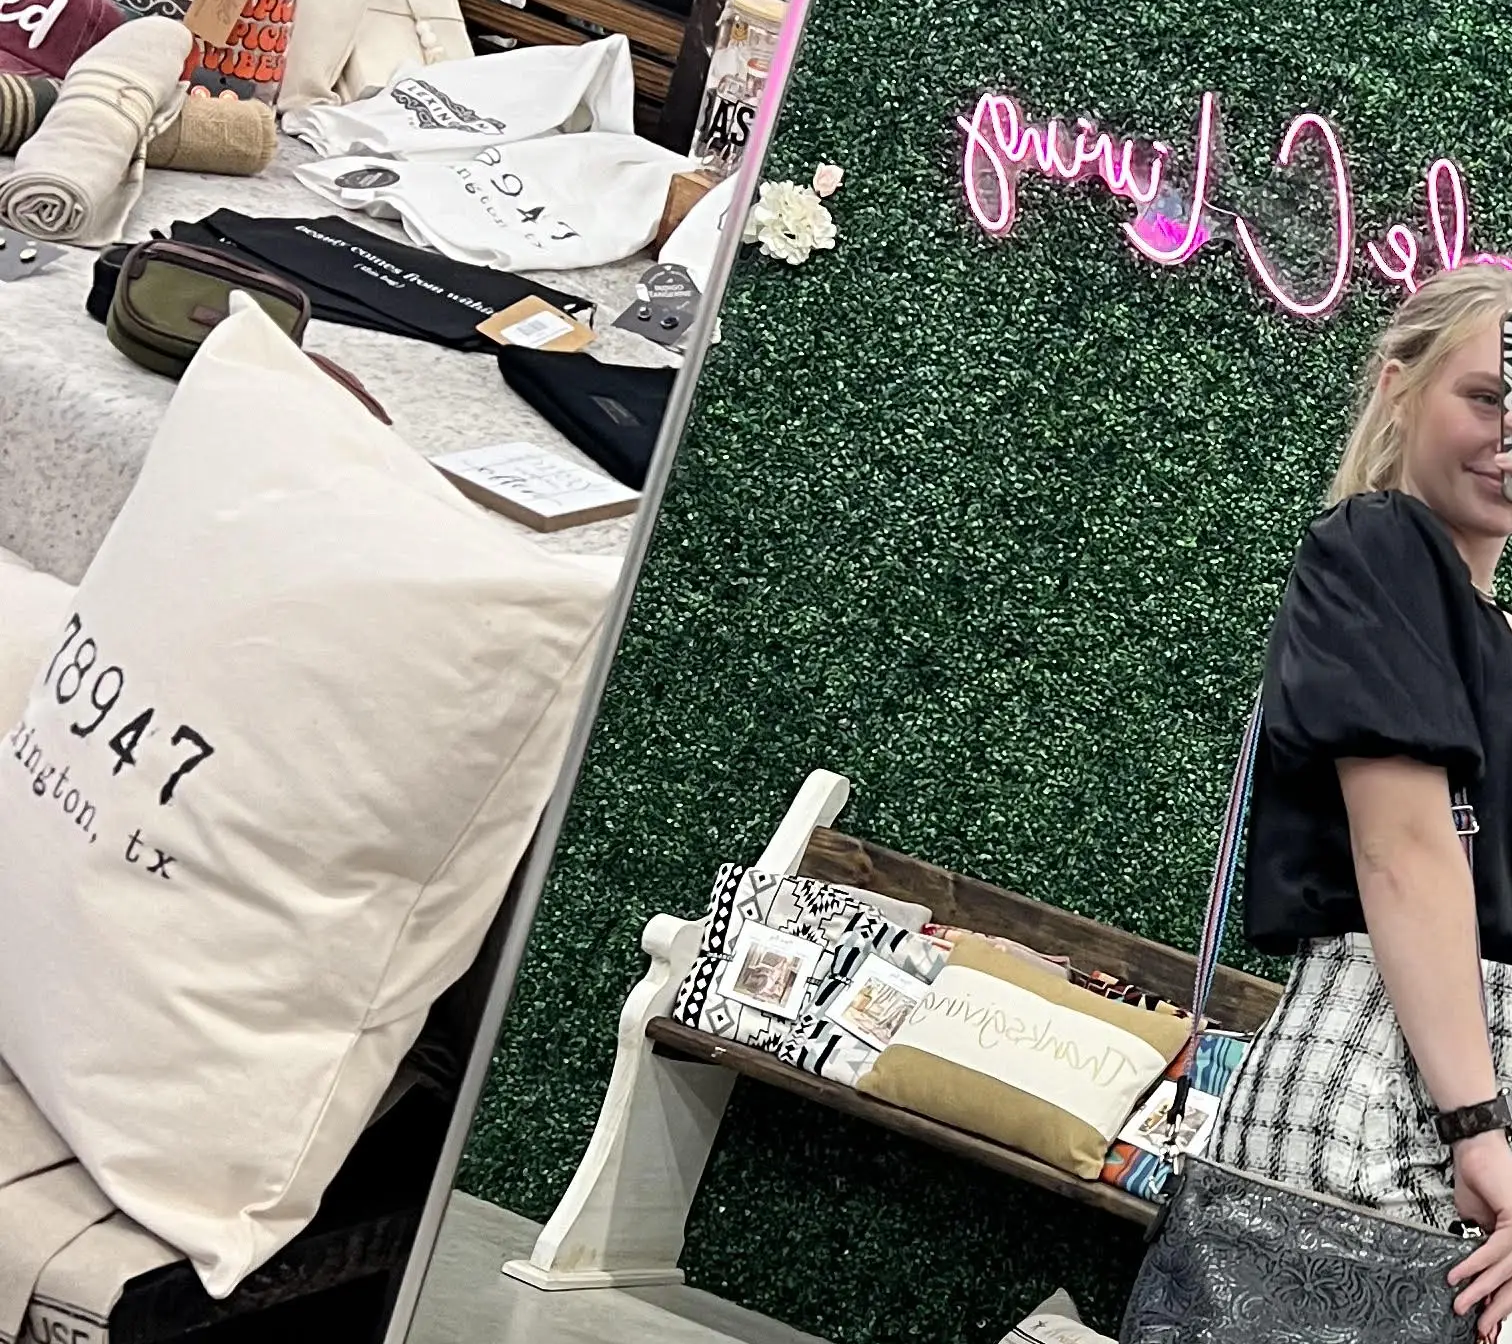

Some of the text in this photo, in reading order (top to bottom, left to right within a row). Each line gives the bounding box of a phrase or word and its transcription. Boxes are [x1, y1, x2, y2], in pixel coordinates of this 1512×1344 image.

[350, 246, 403, 274] comes
[402, 272, 444, 294] from
[44, 612, 214, 805] 78947
[125, 829, 177, 879] tx
